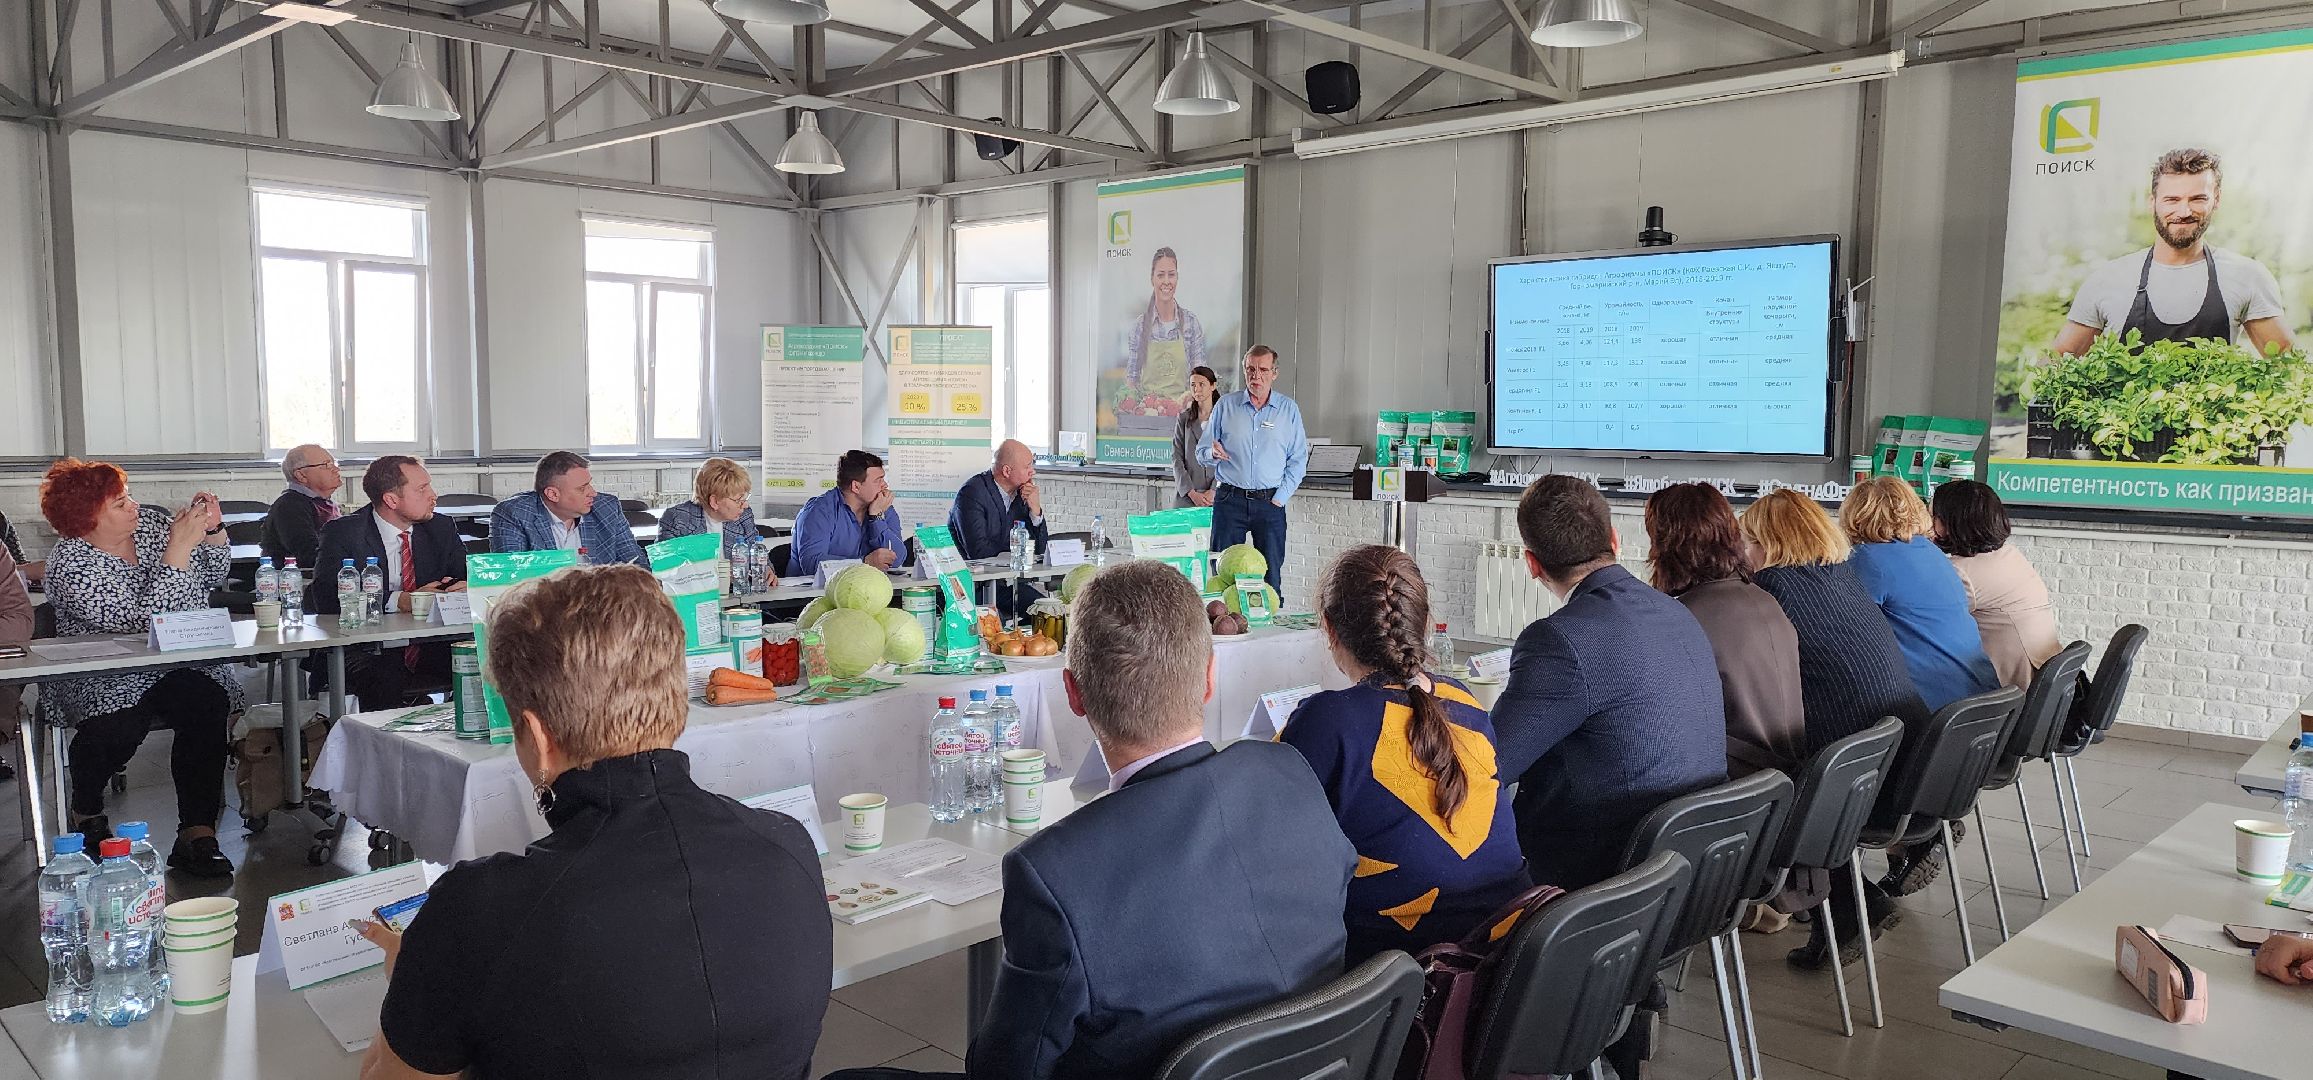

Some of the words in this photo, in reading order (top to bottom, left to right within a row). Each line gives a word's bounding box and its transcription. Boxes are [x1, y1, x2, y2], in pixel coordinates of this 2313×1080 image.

[2035, 159, 2096, 175] ПОИСК
[1106, 248, 1132, 258] ПОИСК
[1104, 444, 1134, 458] Семена
[1997, 470, 2169, 499] Компетентность
[2176, 482, 2213, 500] как
[284, 924, 340, 947] Светлана
